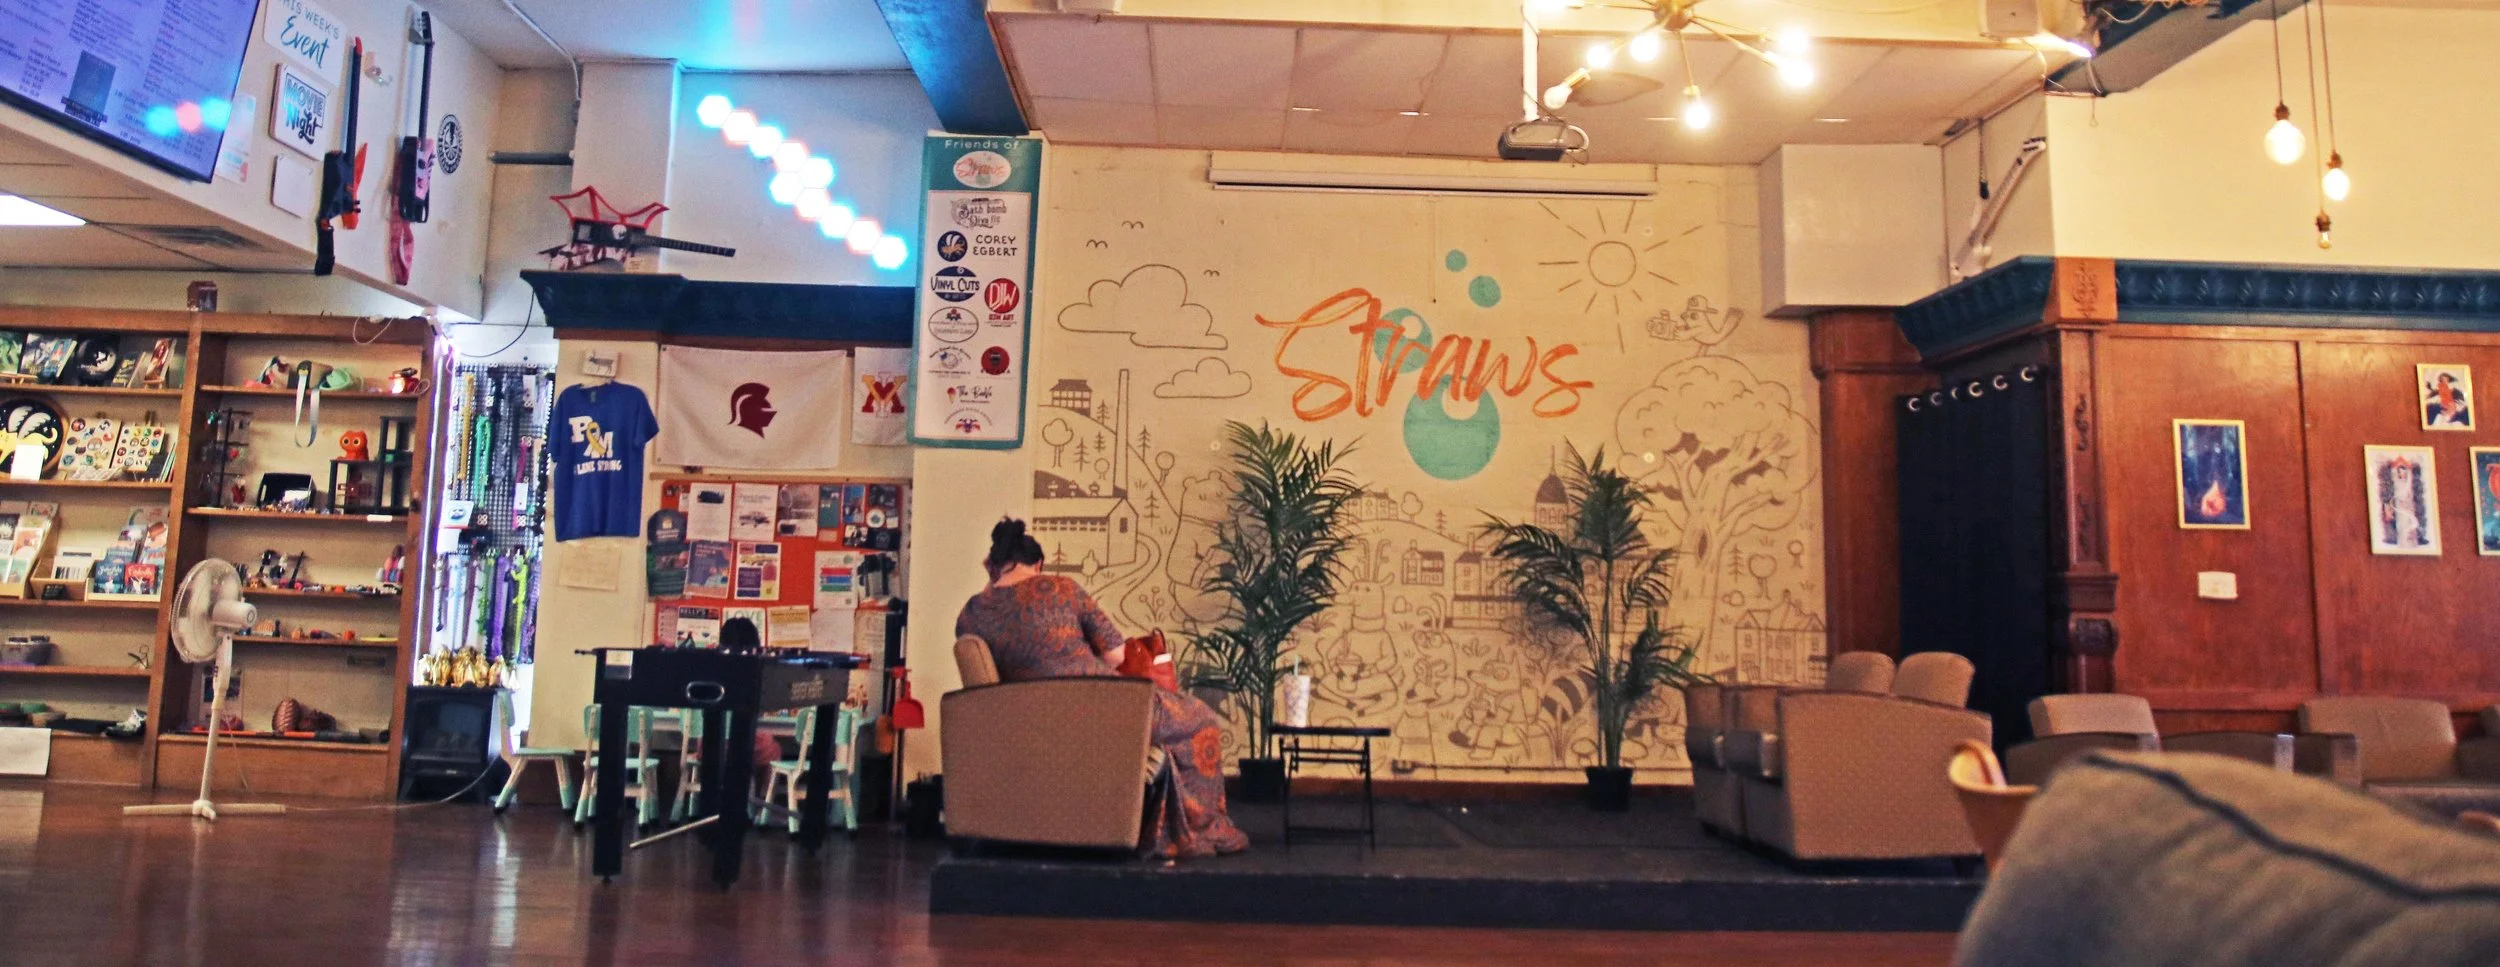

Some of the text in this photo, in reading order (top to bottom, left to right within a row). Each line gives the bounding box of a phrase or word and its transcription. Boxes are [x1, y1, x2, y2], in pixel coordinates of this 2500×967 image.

[281, 15, 330, 68] Event
[285, 102, 322, 145] Night
[944, 139, 1019, 149] Friends of
[973, 247, 1018, 257] EGBERT
[976, 235, 1017, 245] COREY
[1255, 287, 1595, 422] Straws
